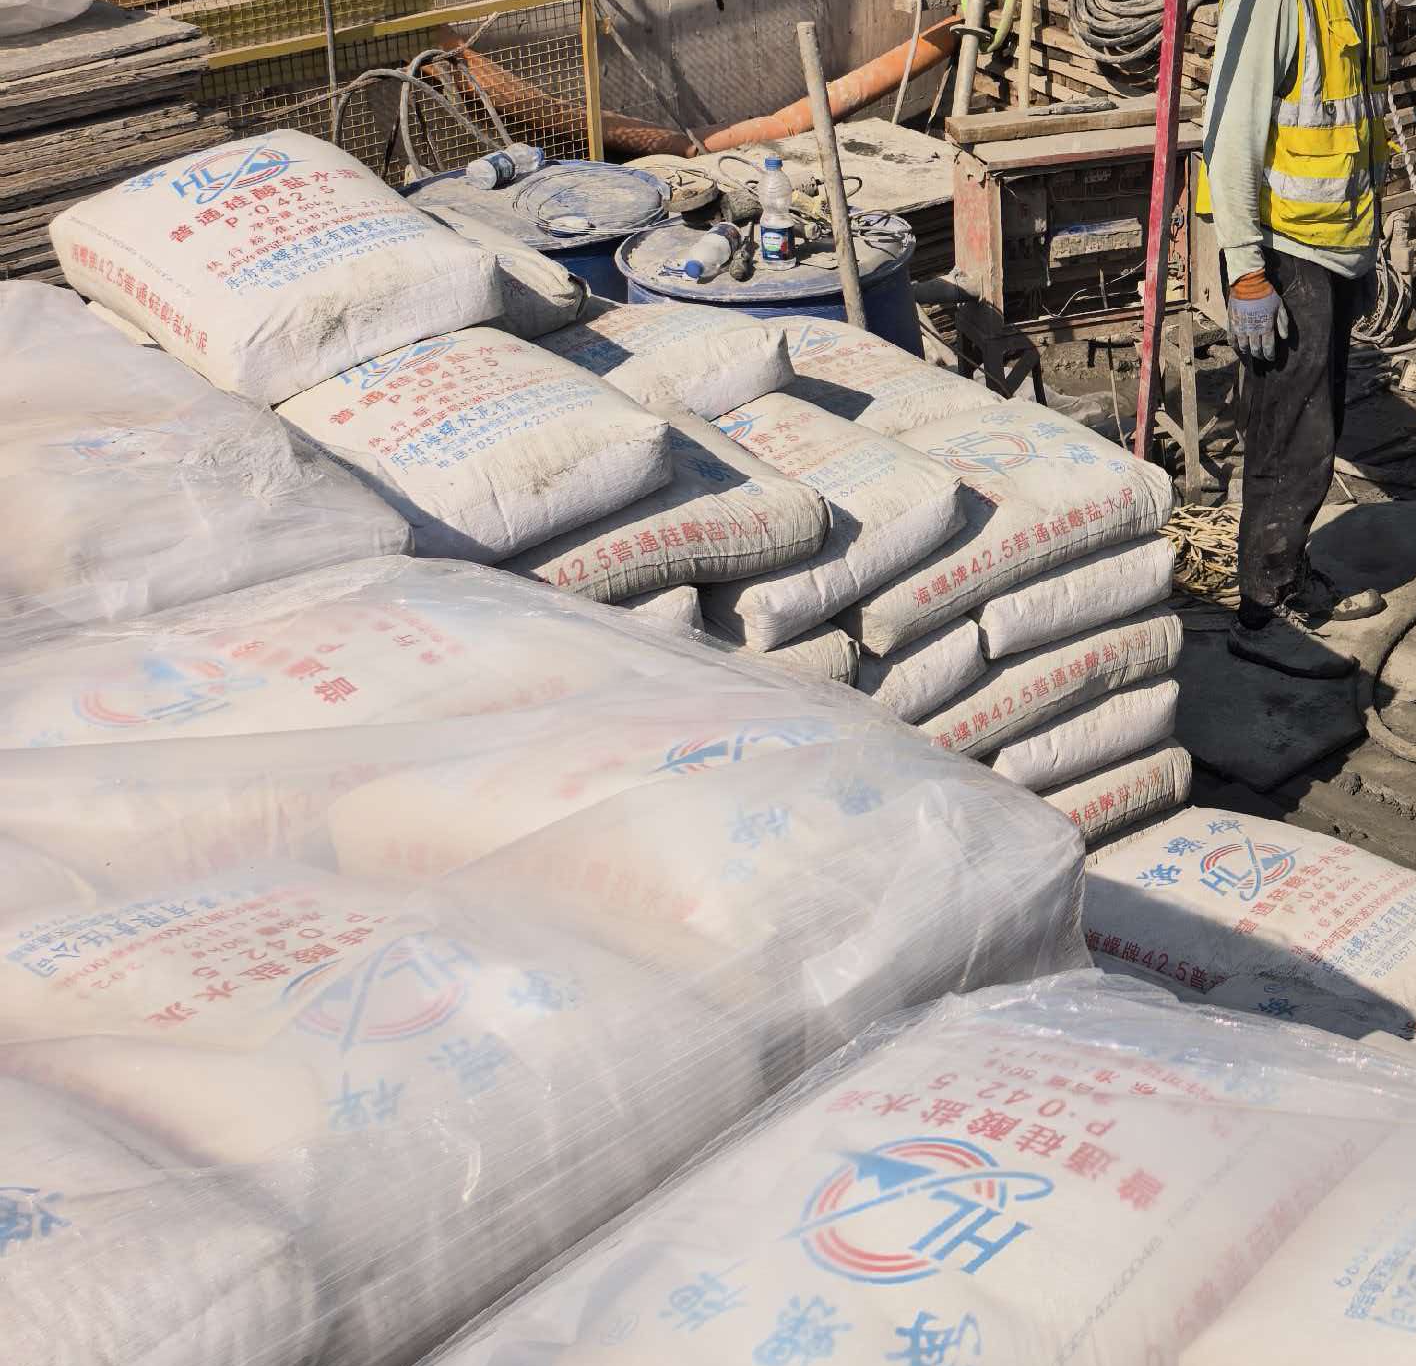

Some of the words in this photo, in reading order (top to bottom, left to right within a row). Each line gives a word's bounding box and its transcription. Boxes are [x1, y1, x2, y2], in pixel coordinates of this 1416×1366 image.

[169, 168, 365, 243] 普通硅酸盐水泥
[171, 165, 232, 199] HL
[913, 485, 1136, 607] 海螺牌42.5普通硅酸盐水泥
[1199, 863, 1254, 897] HL
[910, 1188, 1034, 1276] HL
